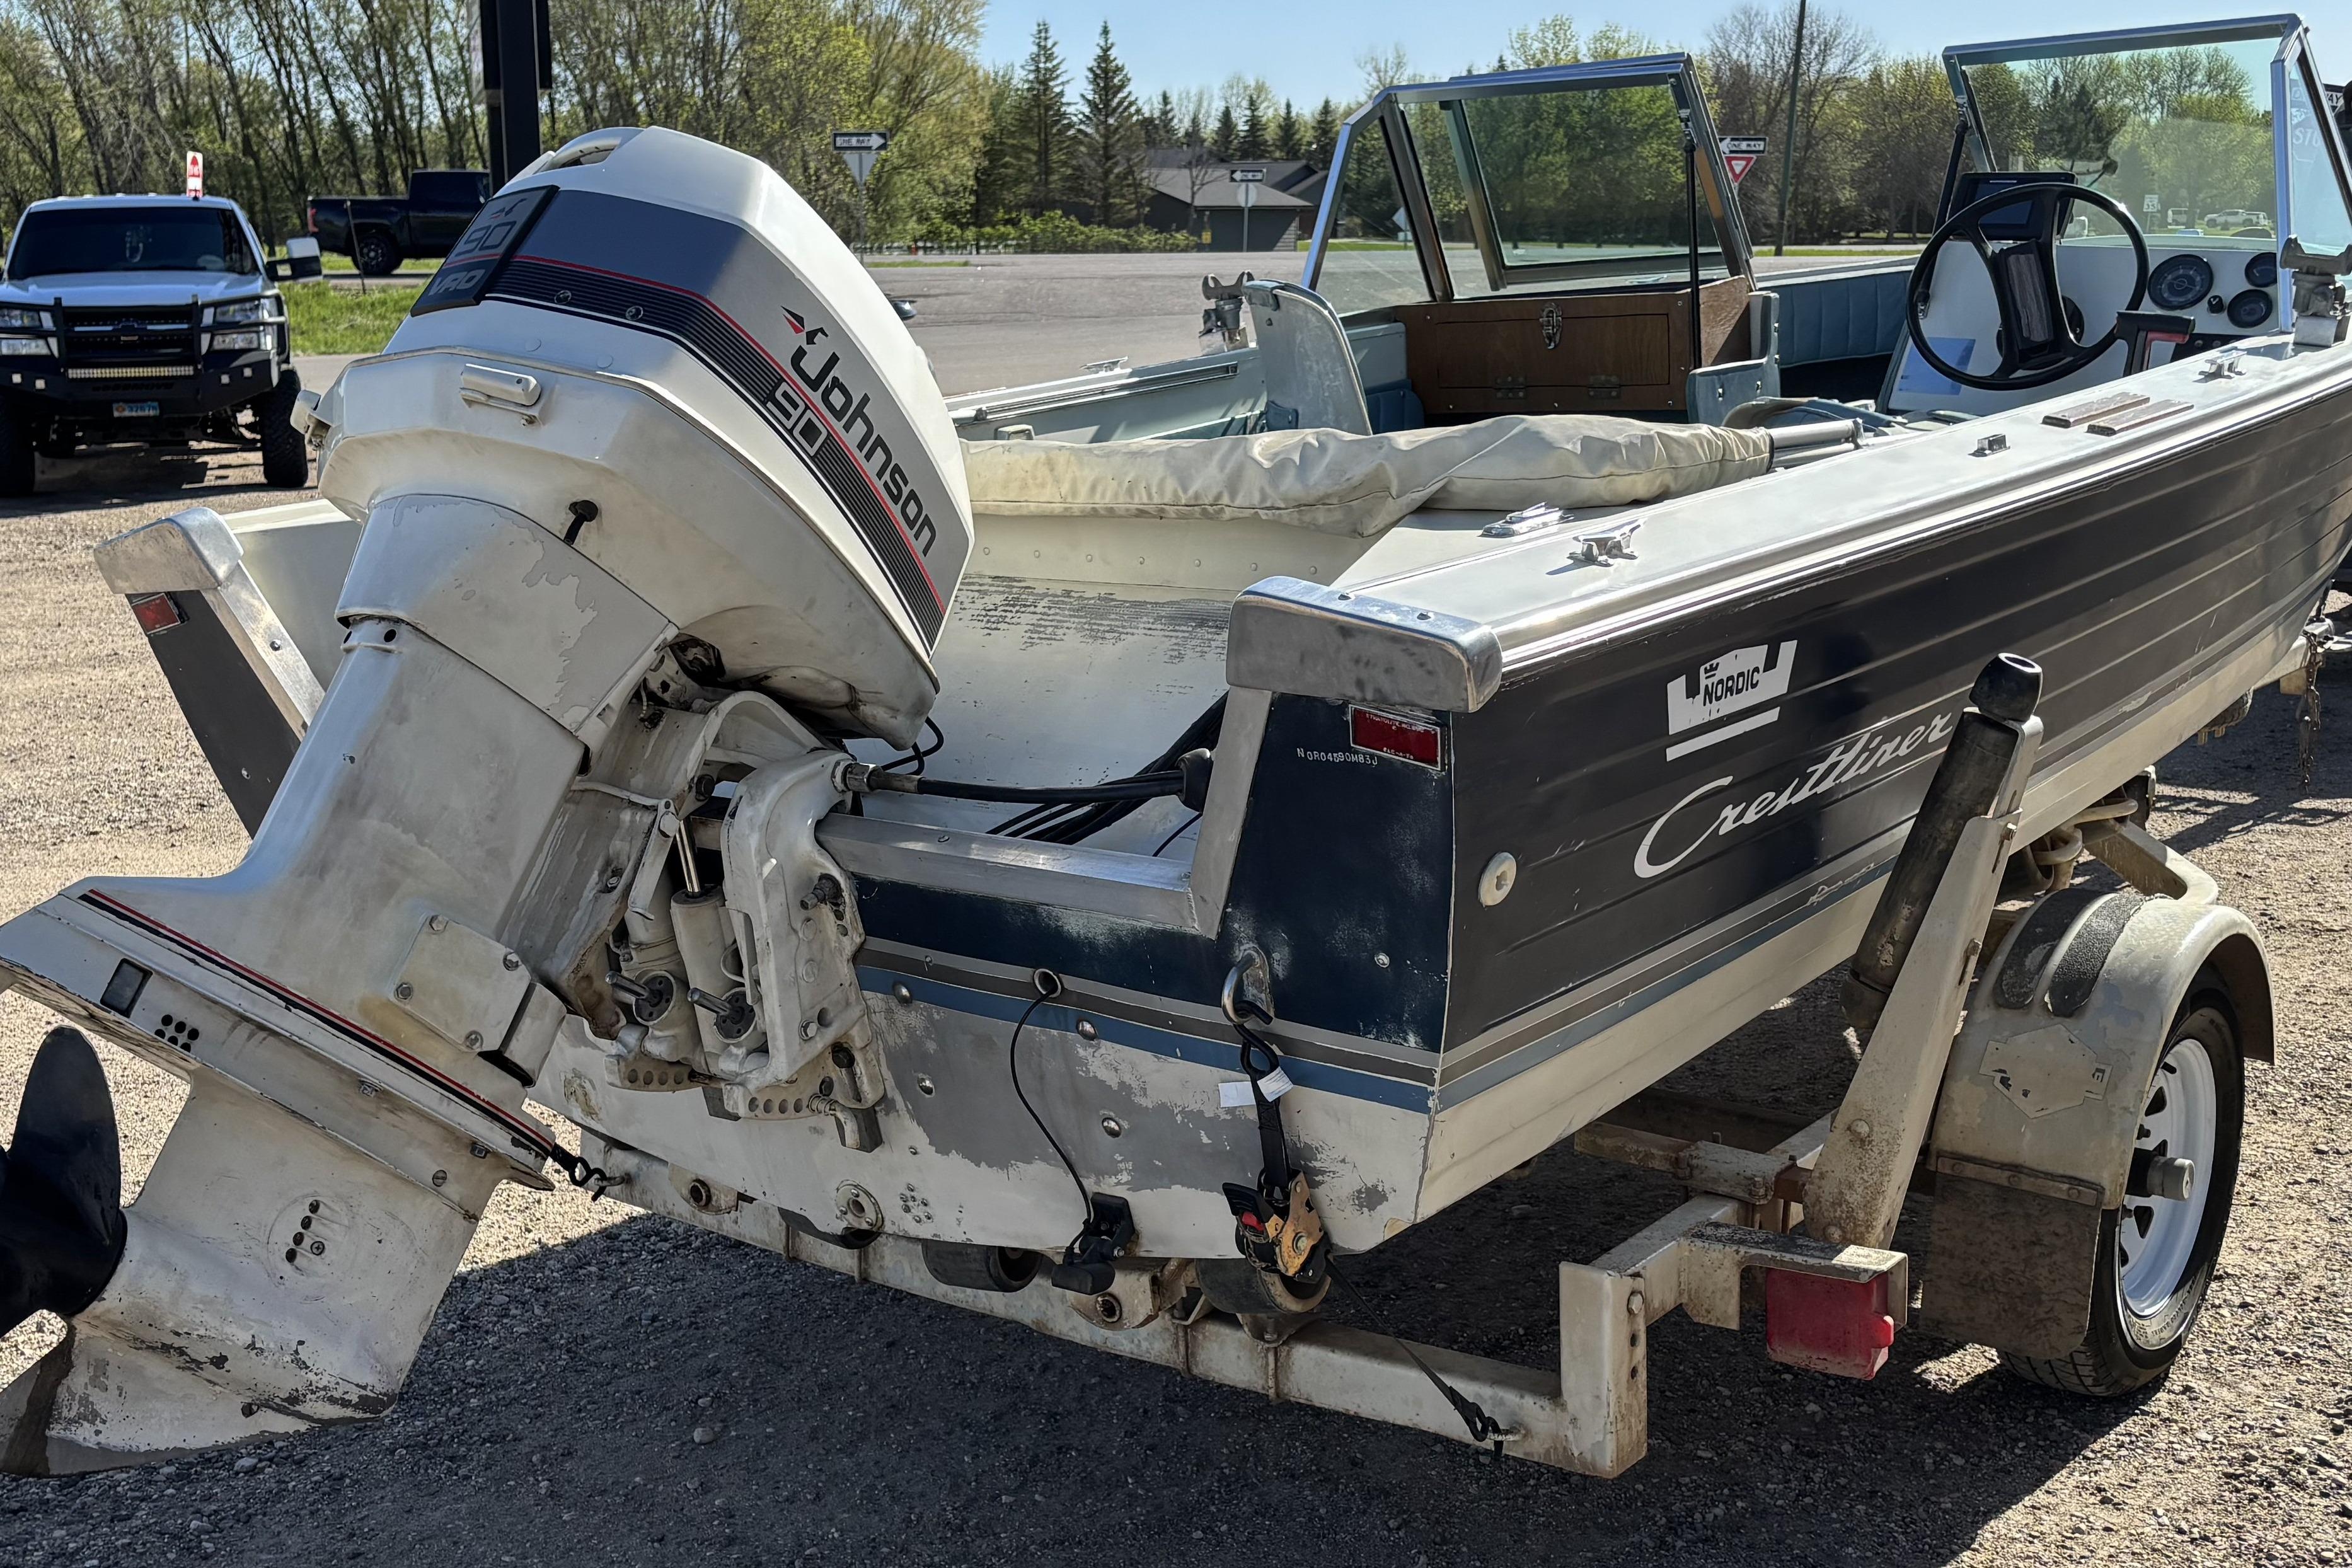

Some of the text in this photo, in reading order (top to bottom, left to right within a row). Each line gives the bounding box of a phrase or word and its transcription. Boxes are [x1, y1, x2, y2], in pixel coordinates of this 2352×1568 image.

[454, 221, 517, 257] 90
[427, 268, 486, 297] VRO
[766, 381, 829, 458] 90
[790, 344, 937, 558] Johnson
[1703, 666, 1761, 706] NORDIC
[1634, 712, 1953, 878] Crestliner
